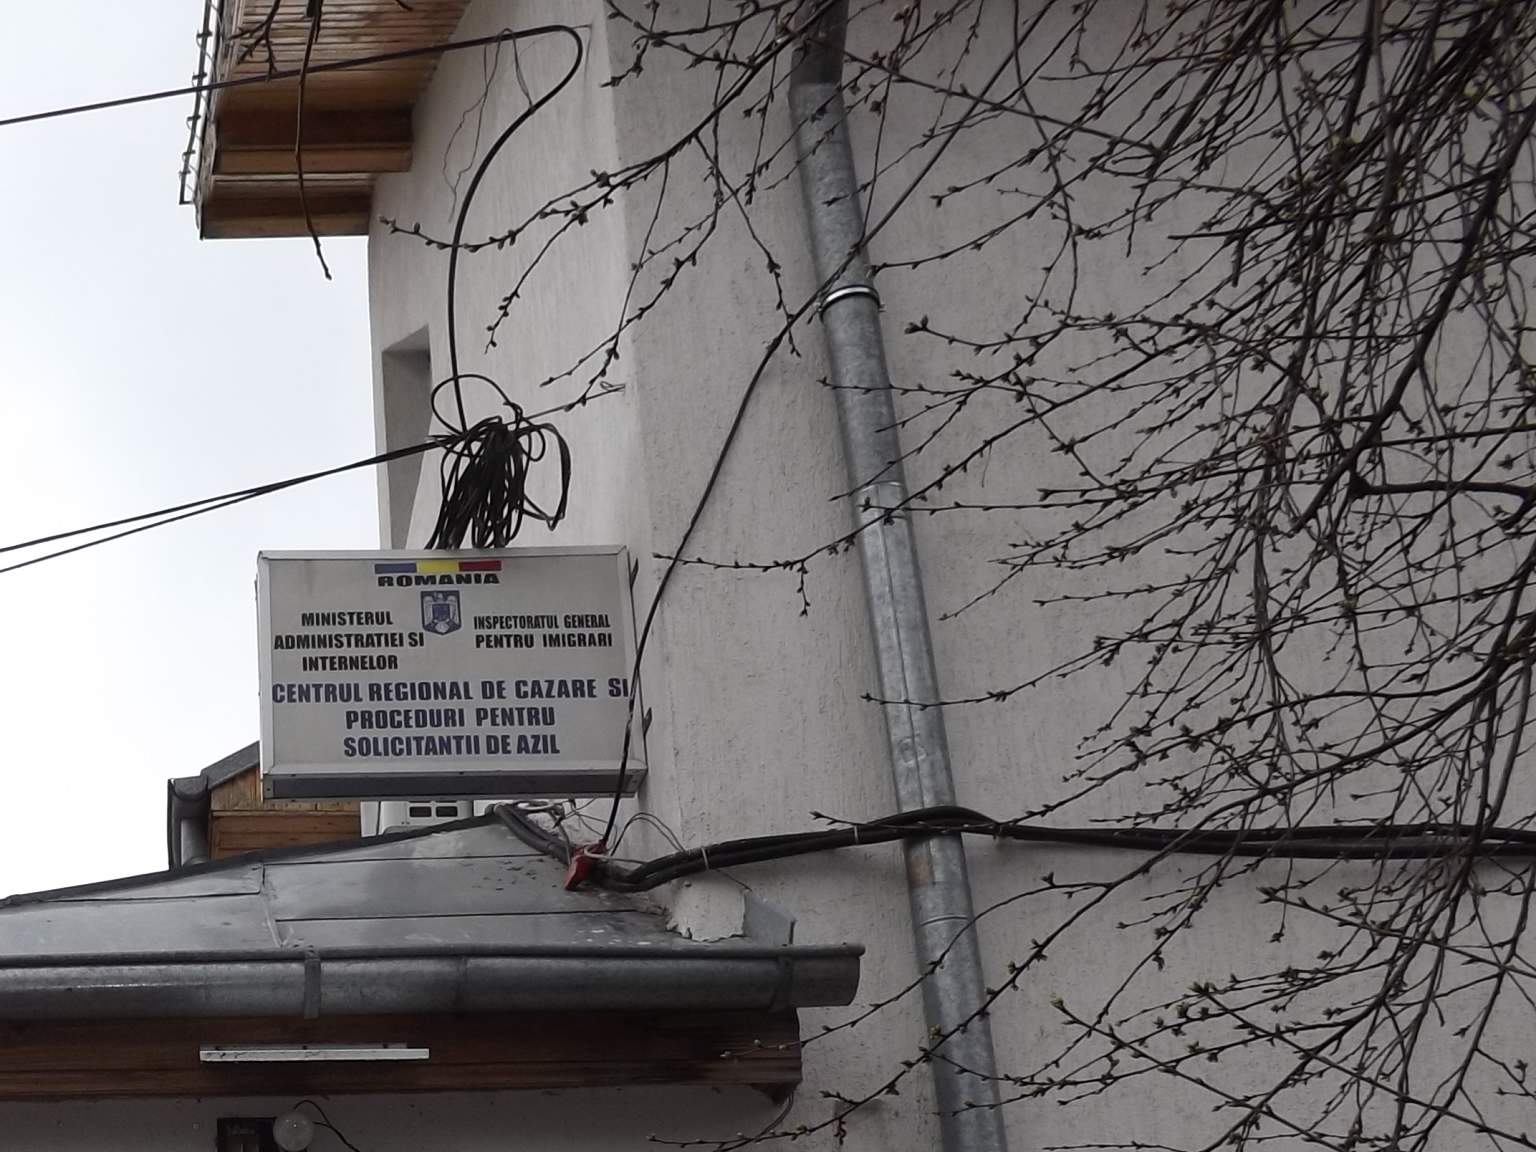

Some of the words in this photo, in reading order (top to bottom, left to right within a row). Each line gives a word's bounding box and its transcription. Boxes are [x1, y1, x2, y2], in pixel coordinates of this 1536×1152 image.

[377, 573, 500, 587] ROMANIA
[301, 611, 394, 627] MINISTERUL
[473, 615, 559, 630] INSPECTORATUL
[564, 614, 611, 628] GENERAL
[274, 632, 404, 650] ADMINISTRATIEI
[408, 632, 424, 647] SI
[475, 634, 535, 649] PENTRU
[542, 633, 613, 648] IMIGRARI
[302, 655, 398, 671] INTERNELOR
[272, 682, 363, 703] CENTRUL
[368, 681, 474, 702] REGIONAL
[481, 680, 507, 699] DE
[515, 679, 597, 699] CAZARE
[608, 678, 629, 698] SI
[345, 708, 465, 729] PROCEDURI
[475, 707, 556, 727] PENTRU
[343, 735, 480, 757] SOLICITANTII
[486, 735, 512, 755] DE
[516, 734, 561, 754] AZIL
